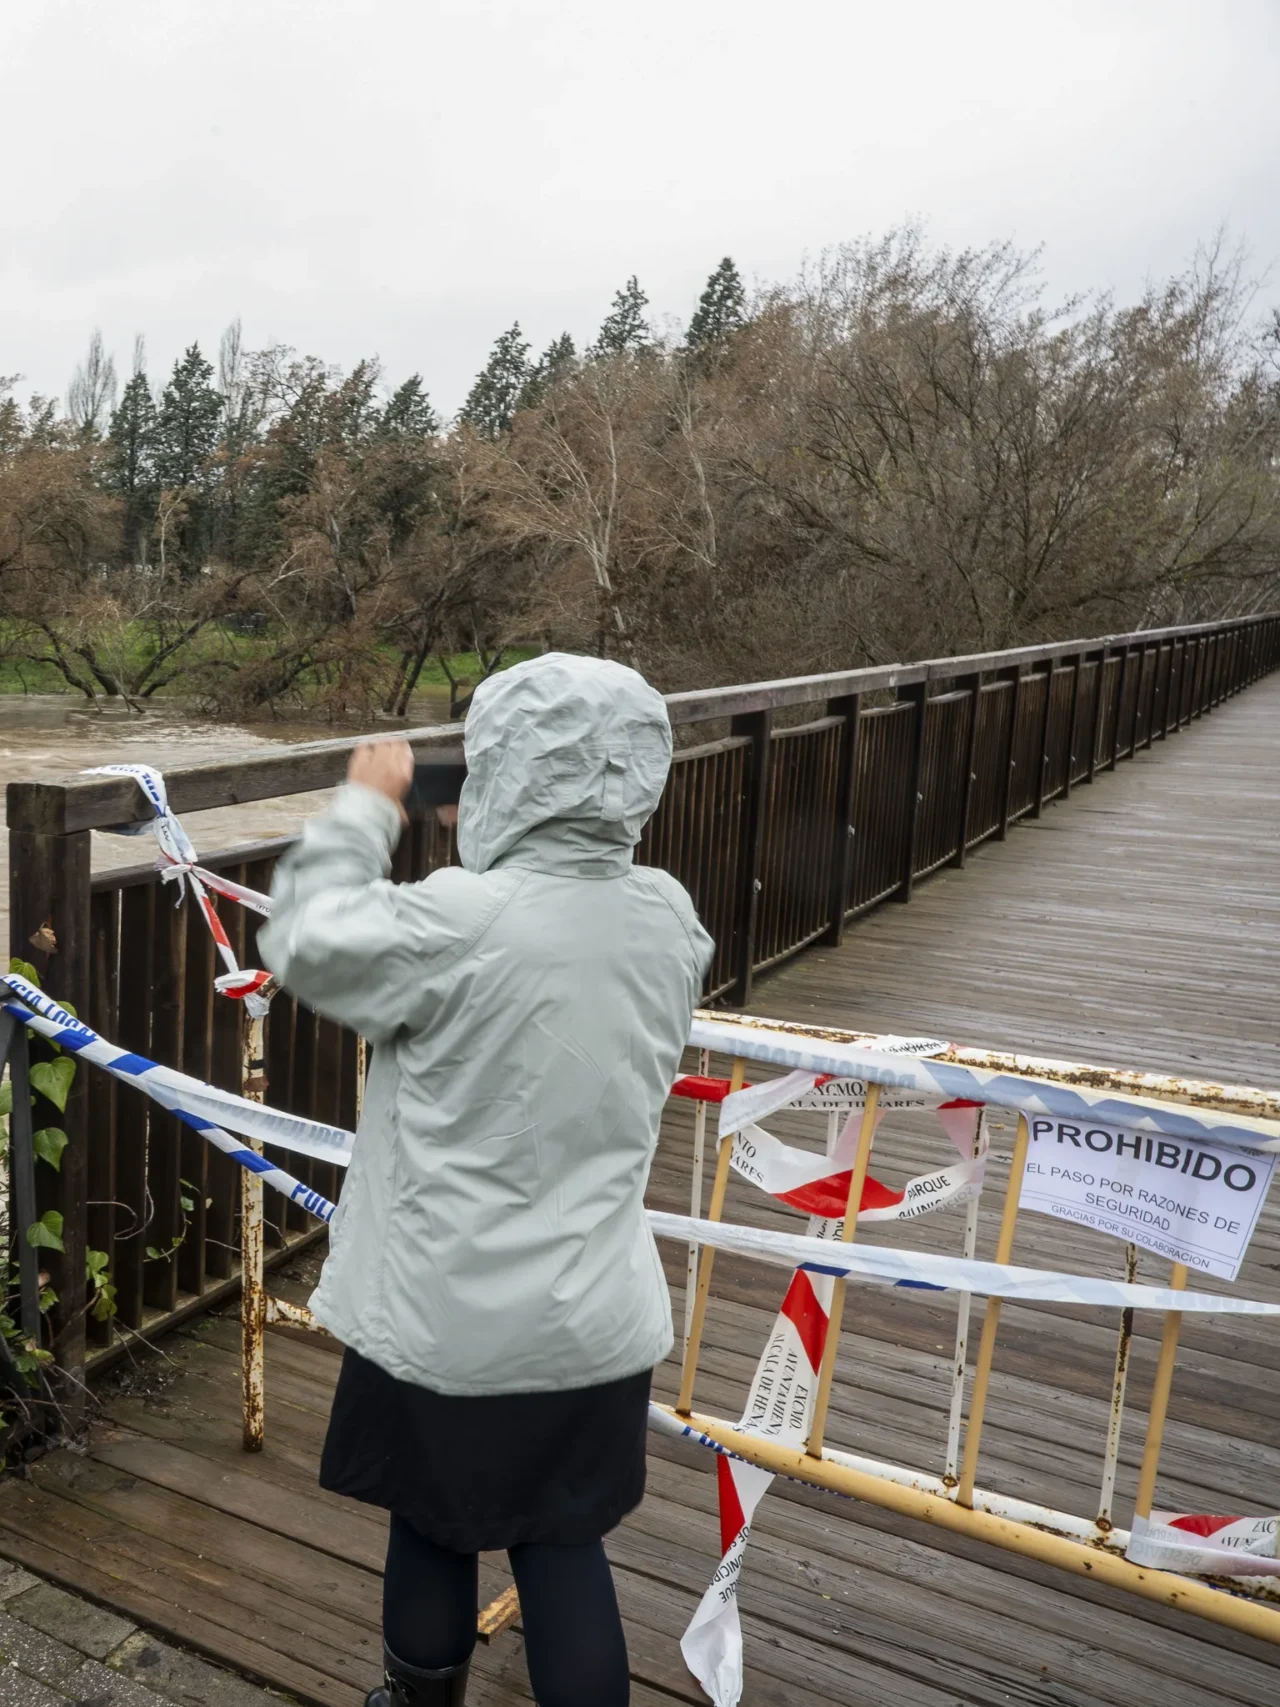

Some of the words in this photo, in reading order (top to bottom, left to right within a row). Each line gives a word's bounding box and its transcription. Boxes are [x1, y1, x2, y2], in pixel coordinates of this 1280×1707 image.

[1032, 1120, 1257, 1192] PROHIBIDO
[907, 1175, 951, 1202] PARQUE
[1026, 1162, 1046, 1175] EL
[1050, 1166, 1095, 1186] PASO
[1099, 1177, 1134, 1199] POR
[1138, 1188, 1210, 1225] RAZONES
[1213, 1215, 1241, 1235] DE
[1084, 1192, 1171, 1232] SEGURIDAD
[1051, 1204, 1096, 1225] GRACIAS
[1097, 1217, 1120, 1233] POR
[1121, 1227, 1134, 1239] SU
[1135, 1233, 1210, 1269] COLABORACION
[757, 1375, 774, 1395] DE
[789, 1384, 809, 1430] EXCMO.
